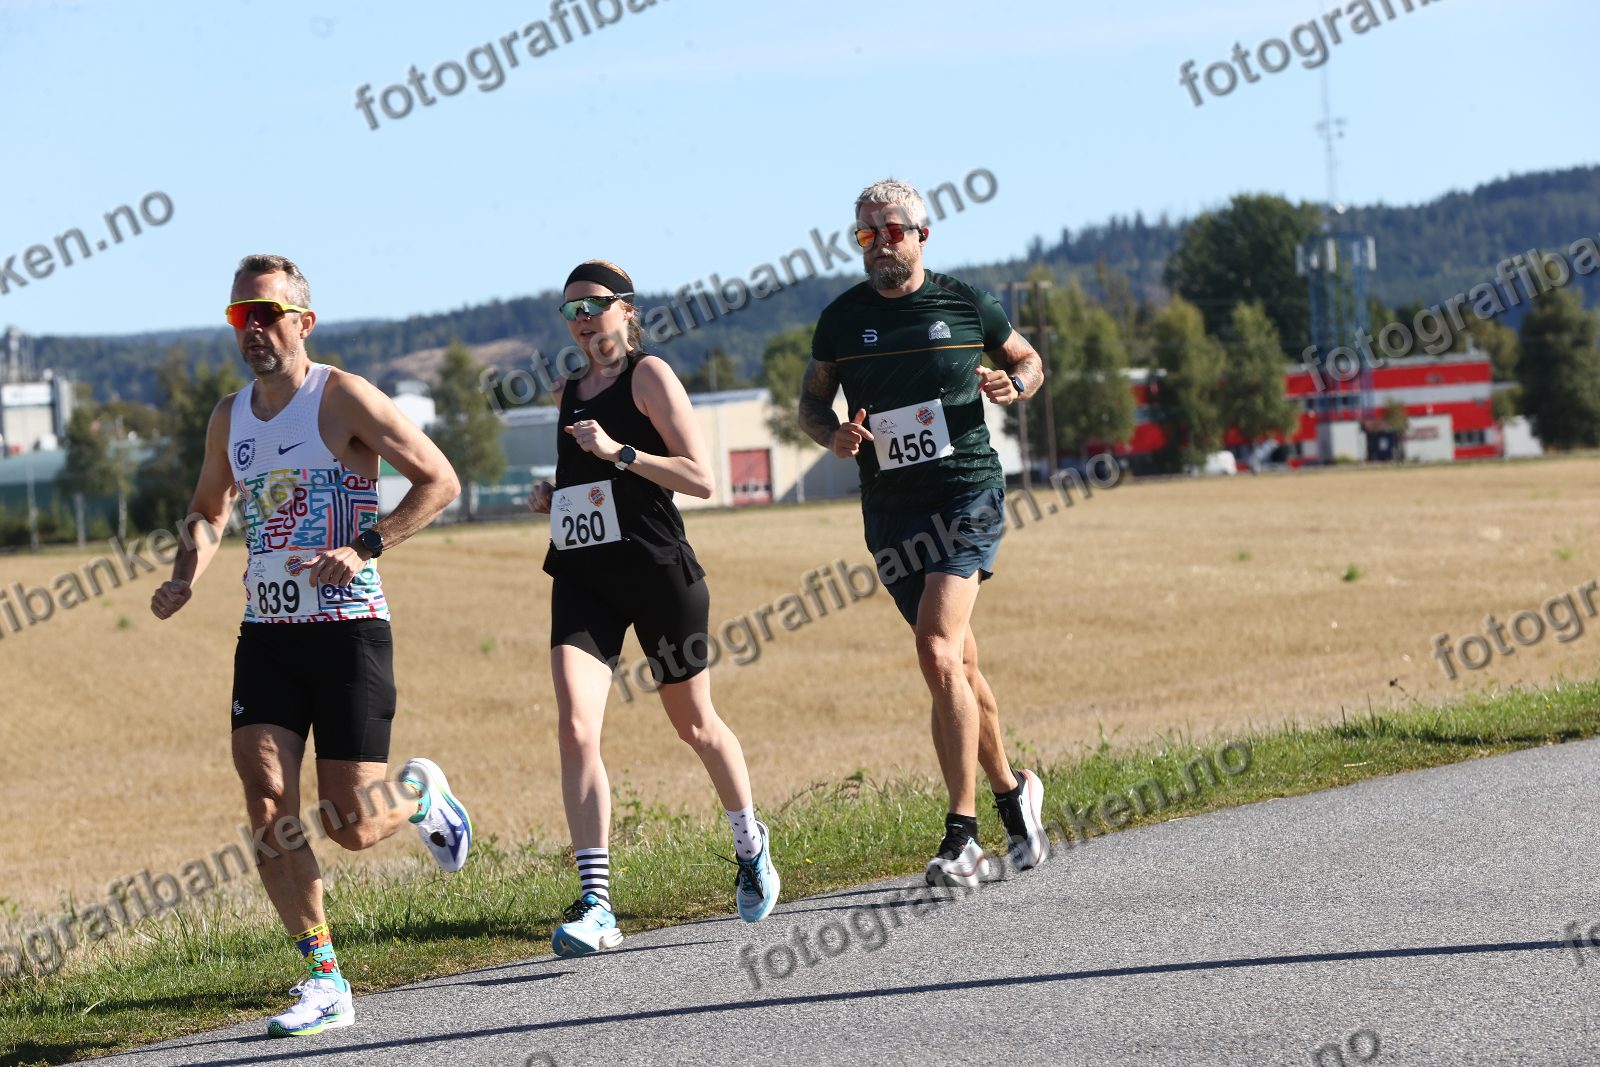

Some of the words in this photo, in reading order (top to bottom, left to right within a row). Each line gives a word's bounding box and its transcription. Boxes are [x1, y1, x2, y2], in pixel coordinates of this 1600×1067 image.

[888, 429, 937, 464] 456
[562, 510, 606, 547] 260
[257, 579, 300, 615] 839
